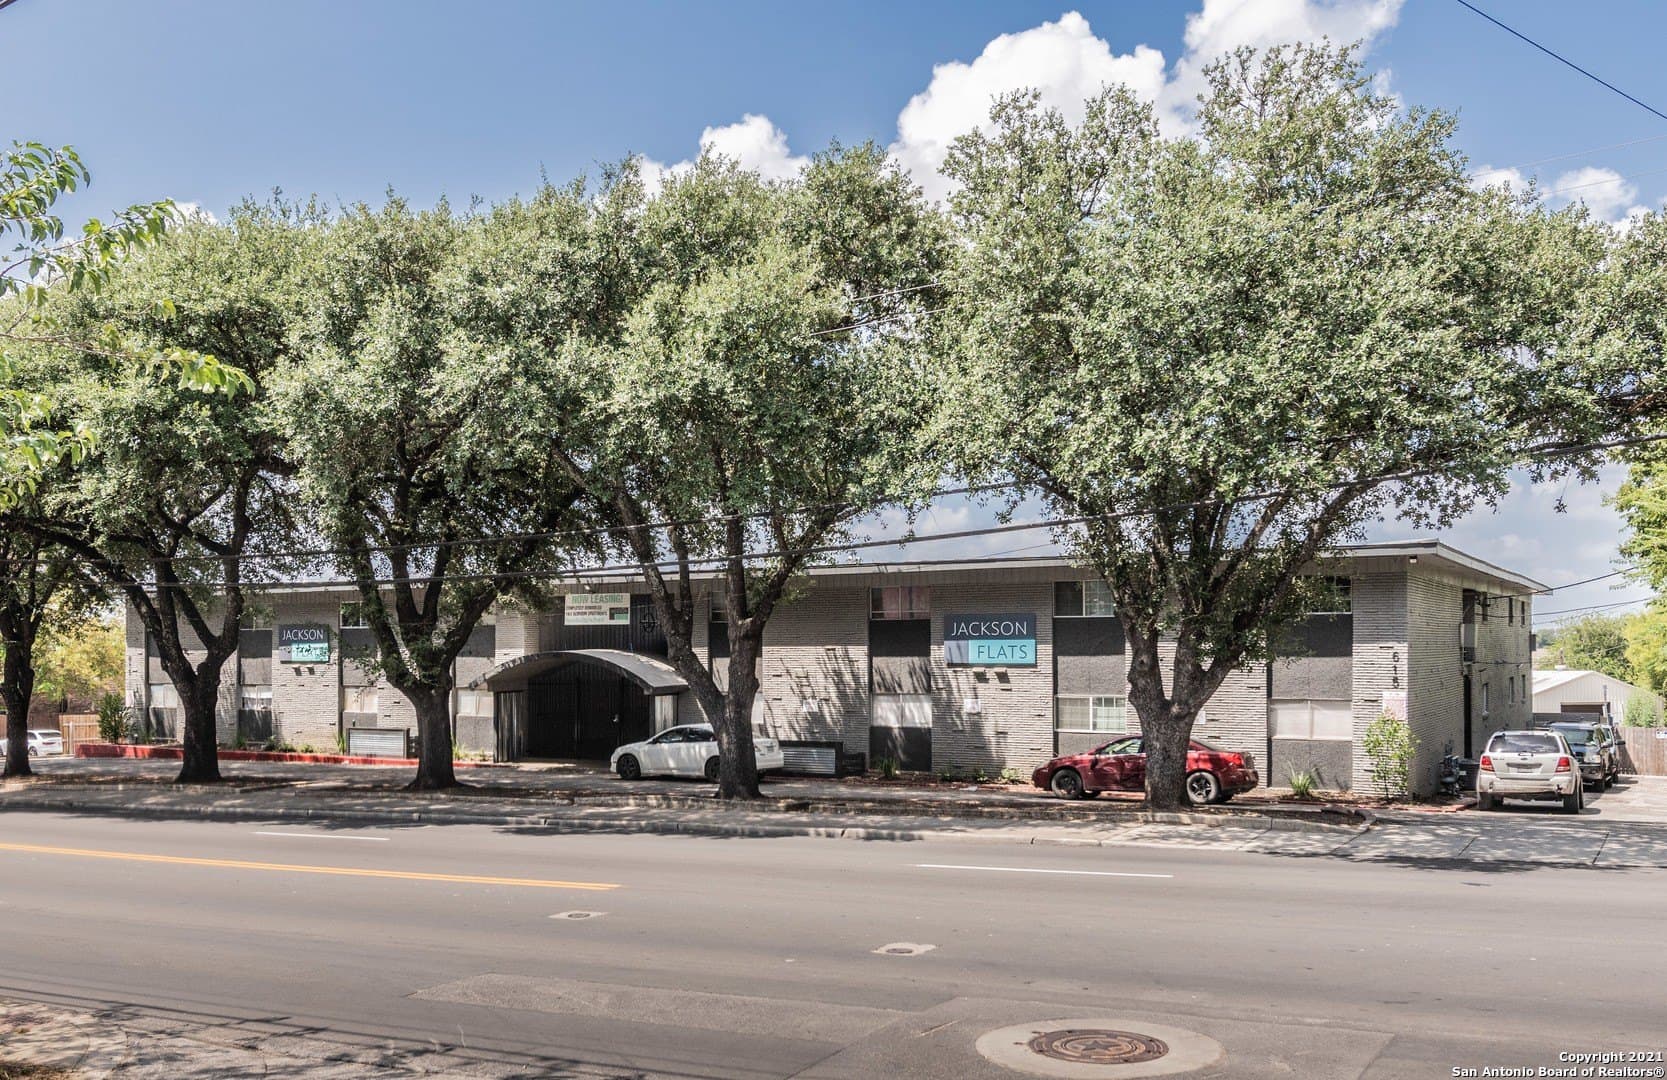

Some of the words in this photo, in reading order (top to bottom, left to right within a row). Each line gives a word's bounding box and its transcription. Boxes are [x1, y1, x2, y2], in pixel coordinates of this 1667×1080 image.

[571, 595, 589, 604] NOW
[590, 594, 624, 604] LEASING!
[282, 629, 324, 641] JACKSON
[951, 621, 1027, 637] JACKSON
[977, 644, 1028, 660] FLATS
